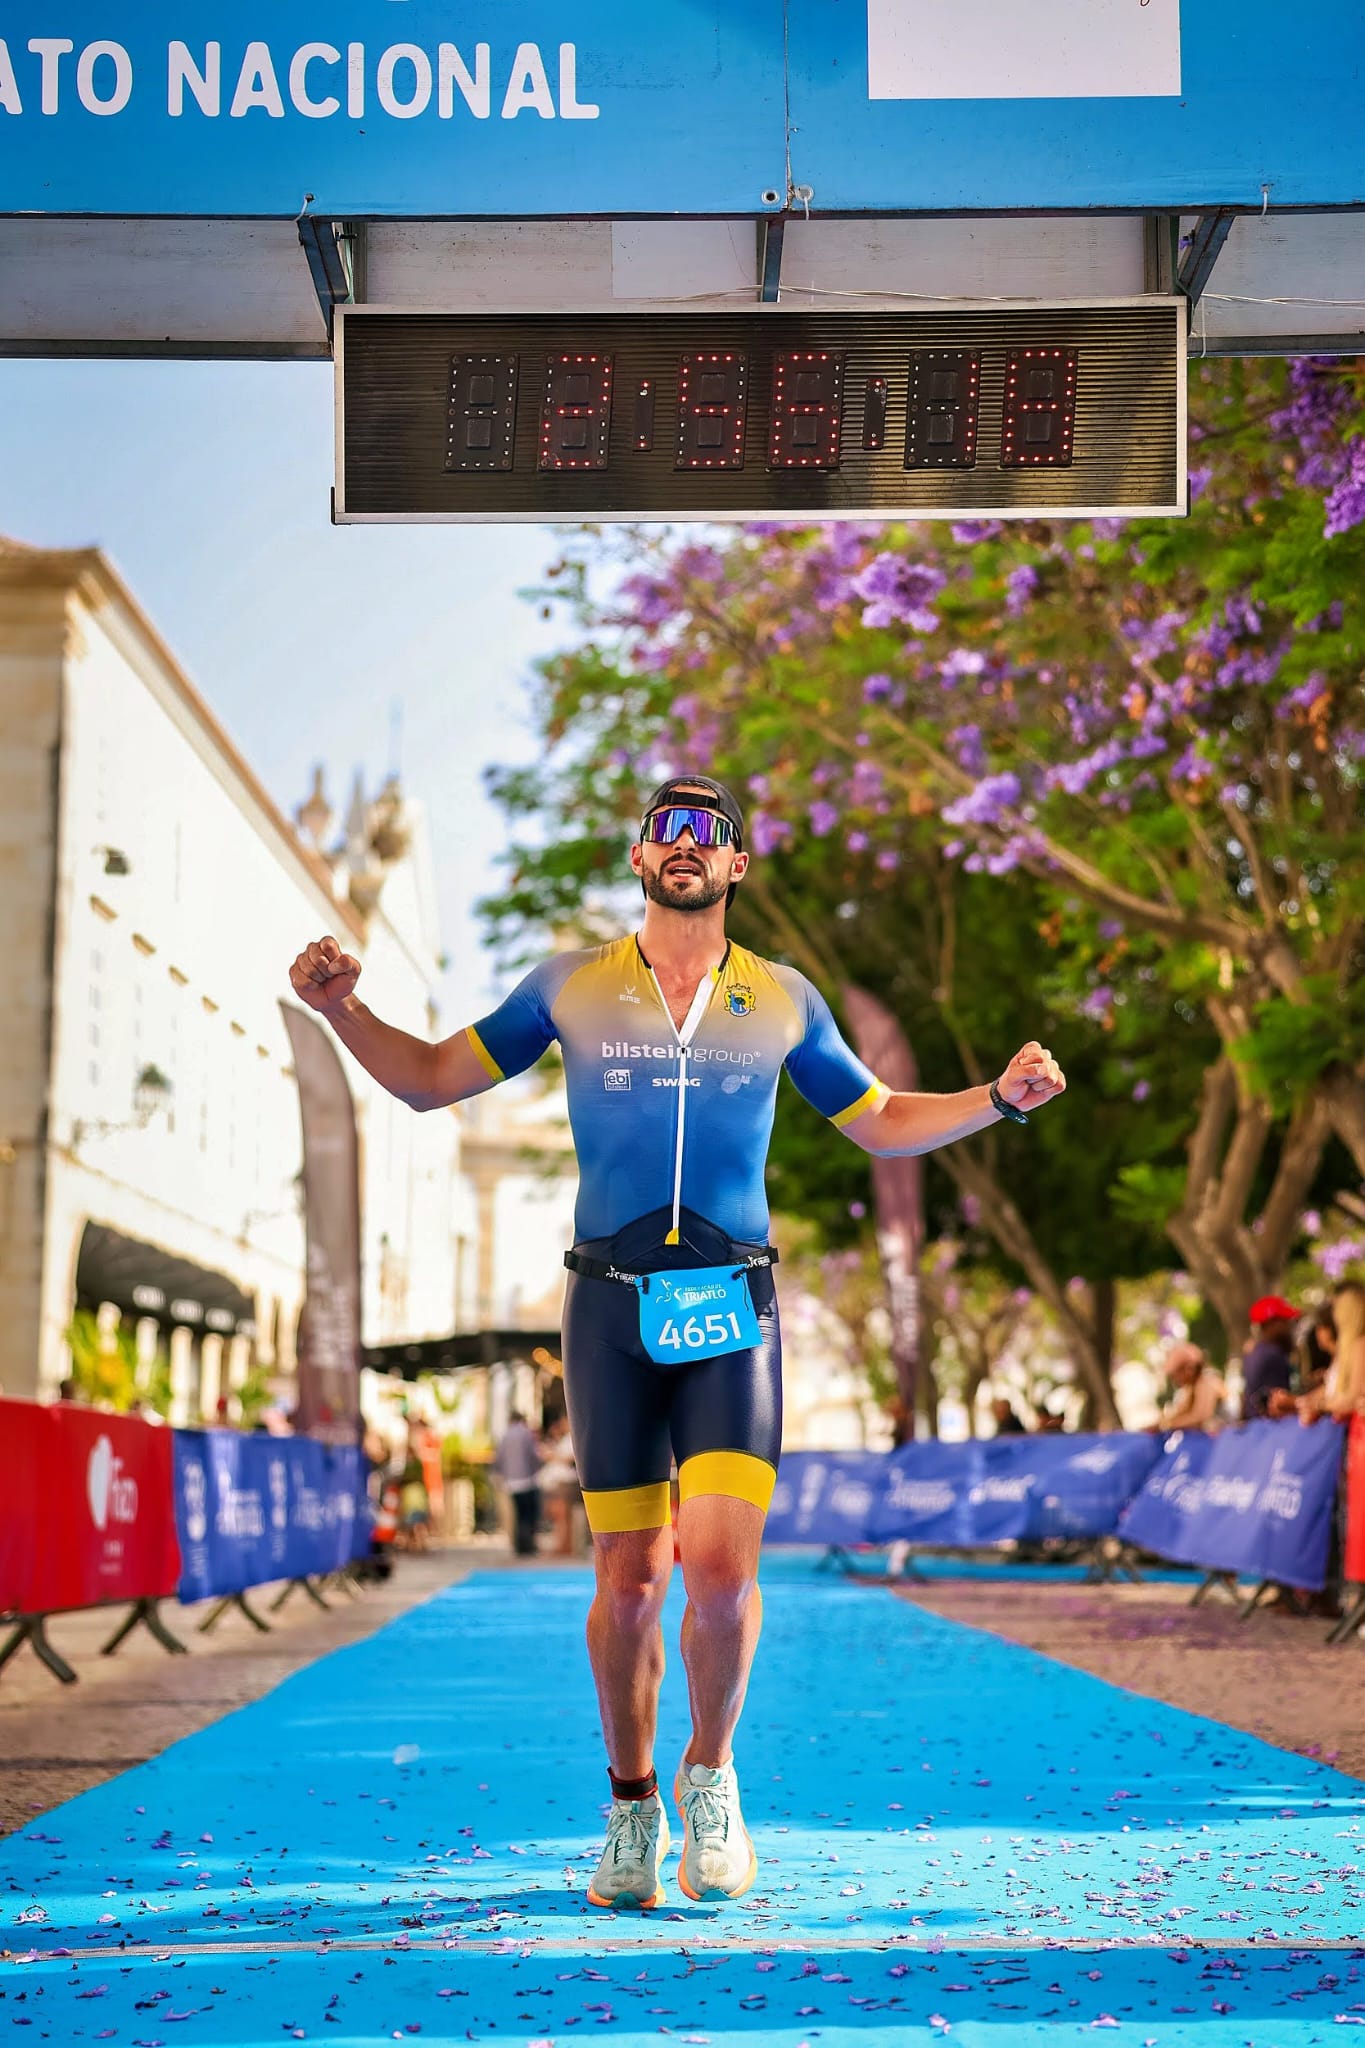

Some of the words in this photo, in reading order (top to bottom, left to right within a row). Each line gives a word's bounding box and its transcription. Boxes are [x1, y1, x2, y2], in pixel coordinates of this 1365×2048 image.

[167, 41, 600, 119] NACIONAL
[651, 1077, 702, 1088] SWAG
[683, 1288, 727, 1302] TRIATLO
[657, 1311, 742, 1350] 4651
